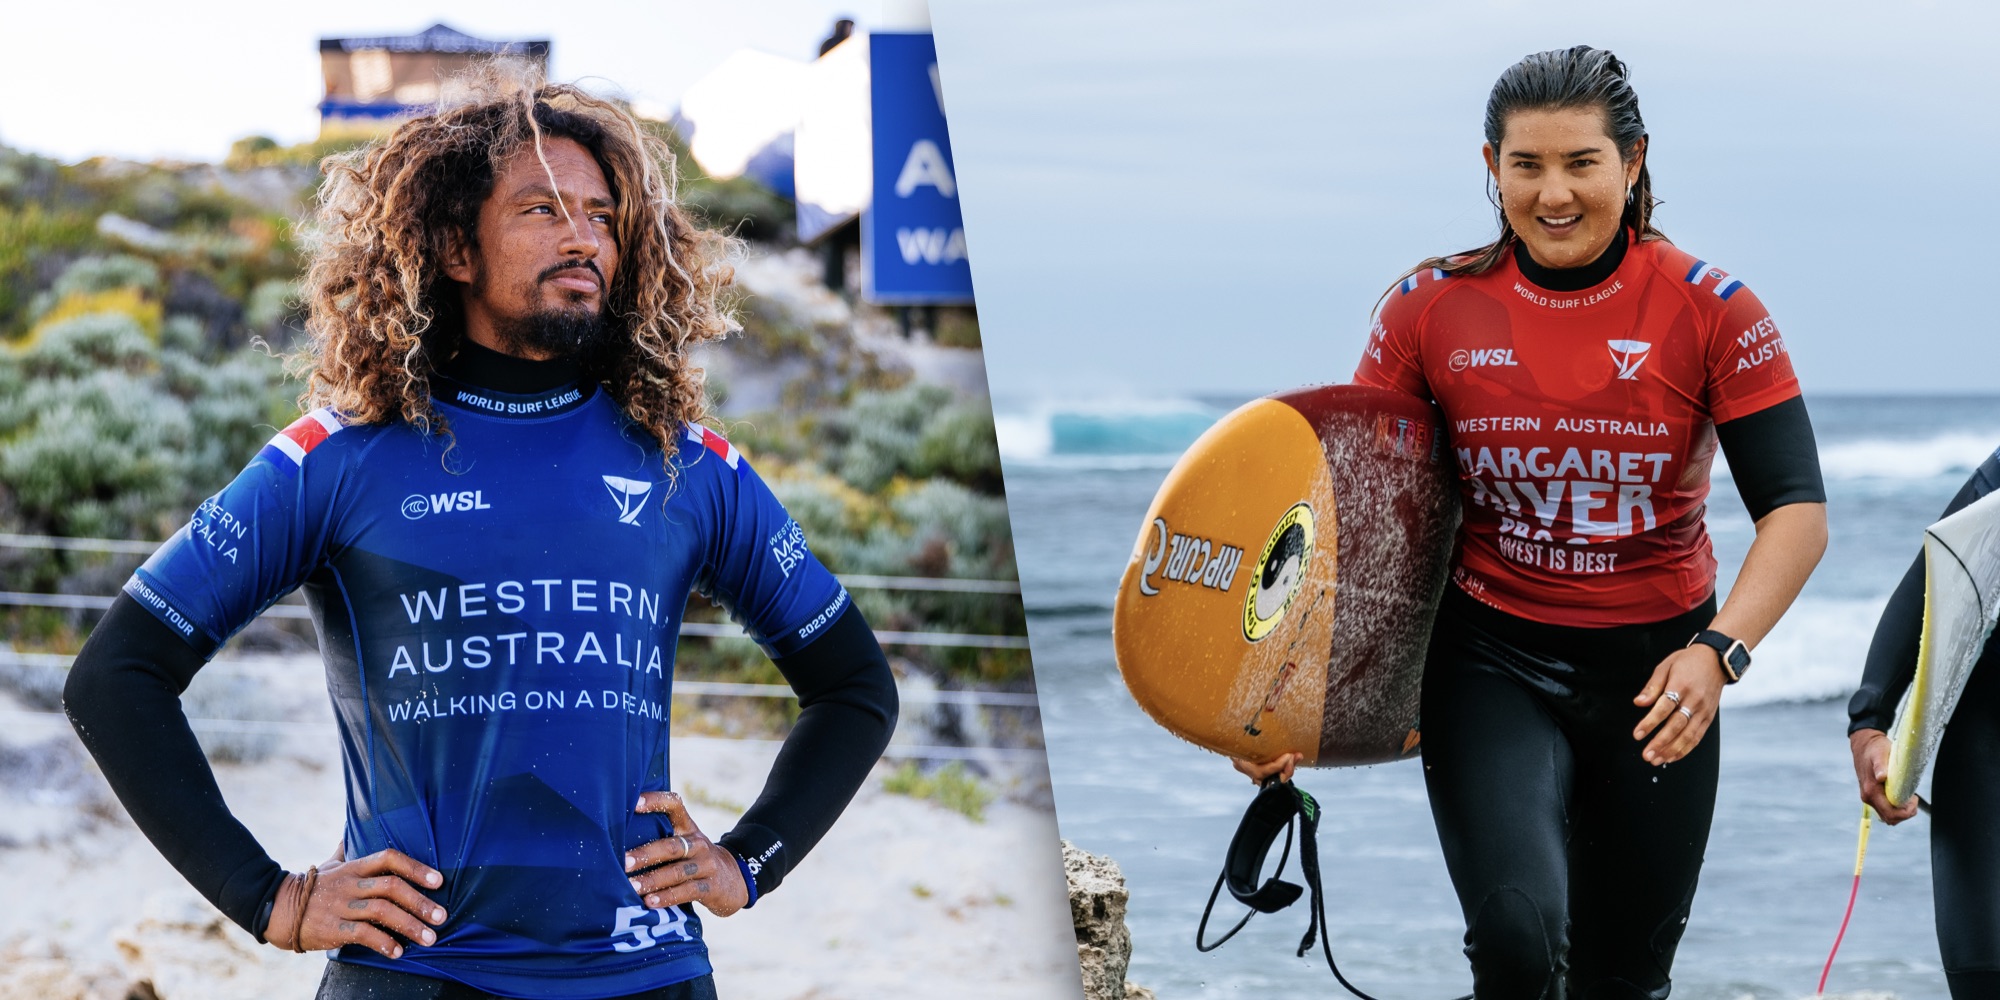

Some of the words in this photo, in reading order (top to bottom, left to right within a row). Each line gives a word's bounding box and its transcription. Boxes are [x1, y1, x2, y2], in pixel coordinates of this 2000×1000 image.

[1513, 281, 1547, 307] WORLD
[1550, 299, 1580, 309] SURF
[1583, 280, 1624, 306] LEAGUE
[1471, 349, 1518, 367] WSL
[456, 391, 505, 412] WORLD
[507, 402, 543, 414] SURF
[545, 388, 583, 410] LEAGUE
[1456, 417, 1541, 433] WESTERN
[1554, 418, 1669, 436] AUSTRALIA
[1457, 446, 1672, 482] MARGARET
[430, 490, 490, 514] WSL
[1472, 478, 1657, 536] RIVER
[1260, 511, 1300, 566] Country
[1499, 535, 1543, 567] WEST
[1550, 547, 1566, 570] IS
[1573, 552, 1618, 573] BEST
[400, 579, 660, 625] WESTERN
[164, 606, 194, 637] TOUR
[798, 613, 827, 638] 2023
[388, 631, 663, 679] AUSTRALIA
[388, 691, 516, 722] WALKING
[525, 690, 565, 710] ON
[575, 690, 594, 708] A
[610, 905, 693, 953] 54
